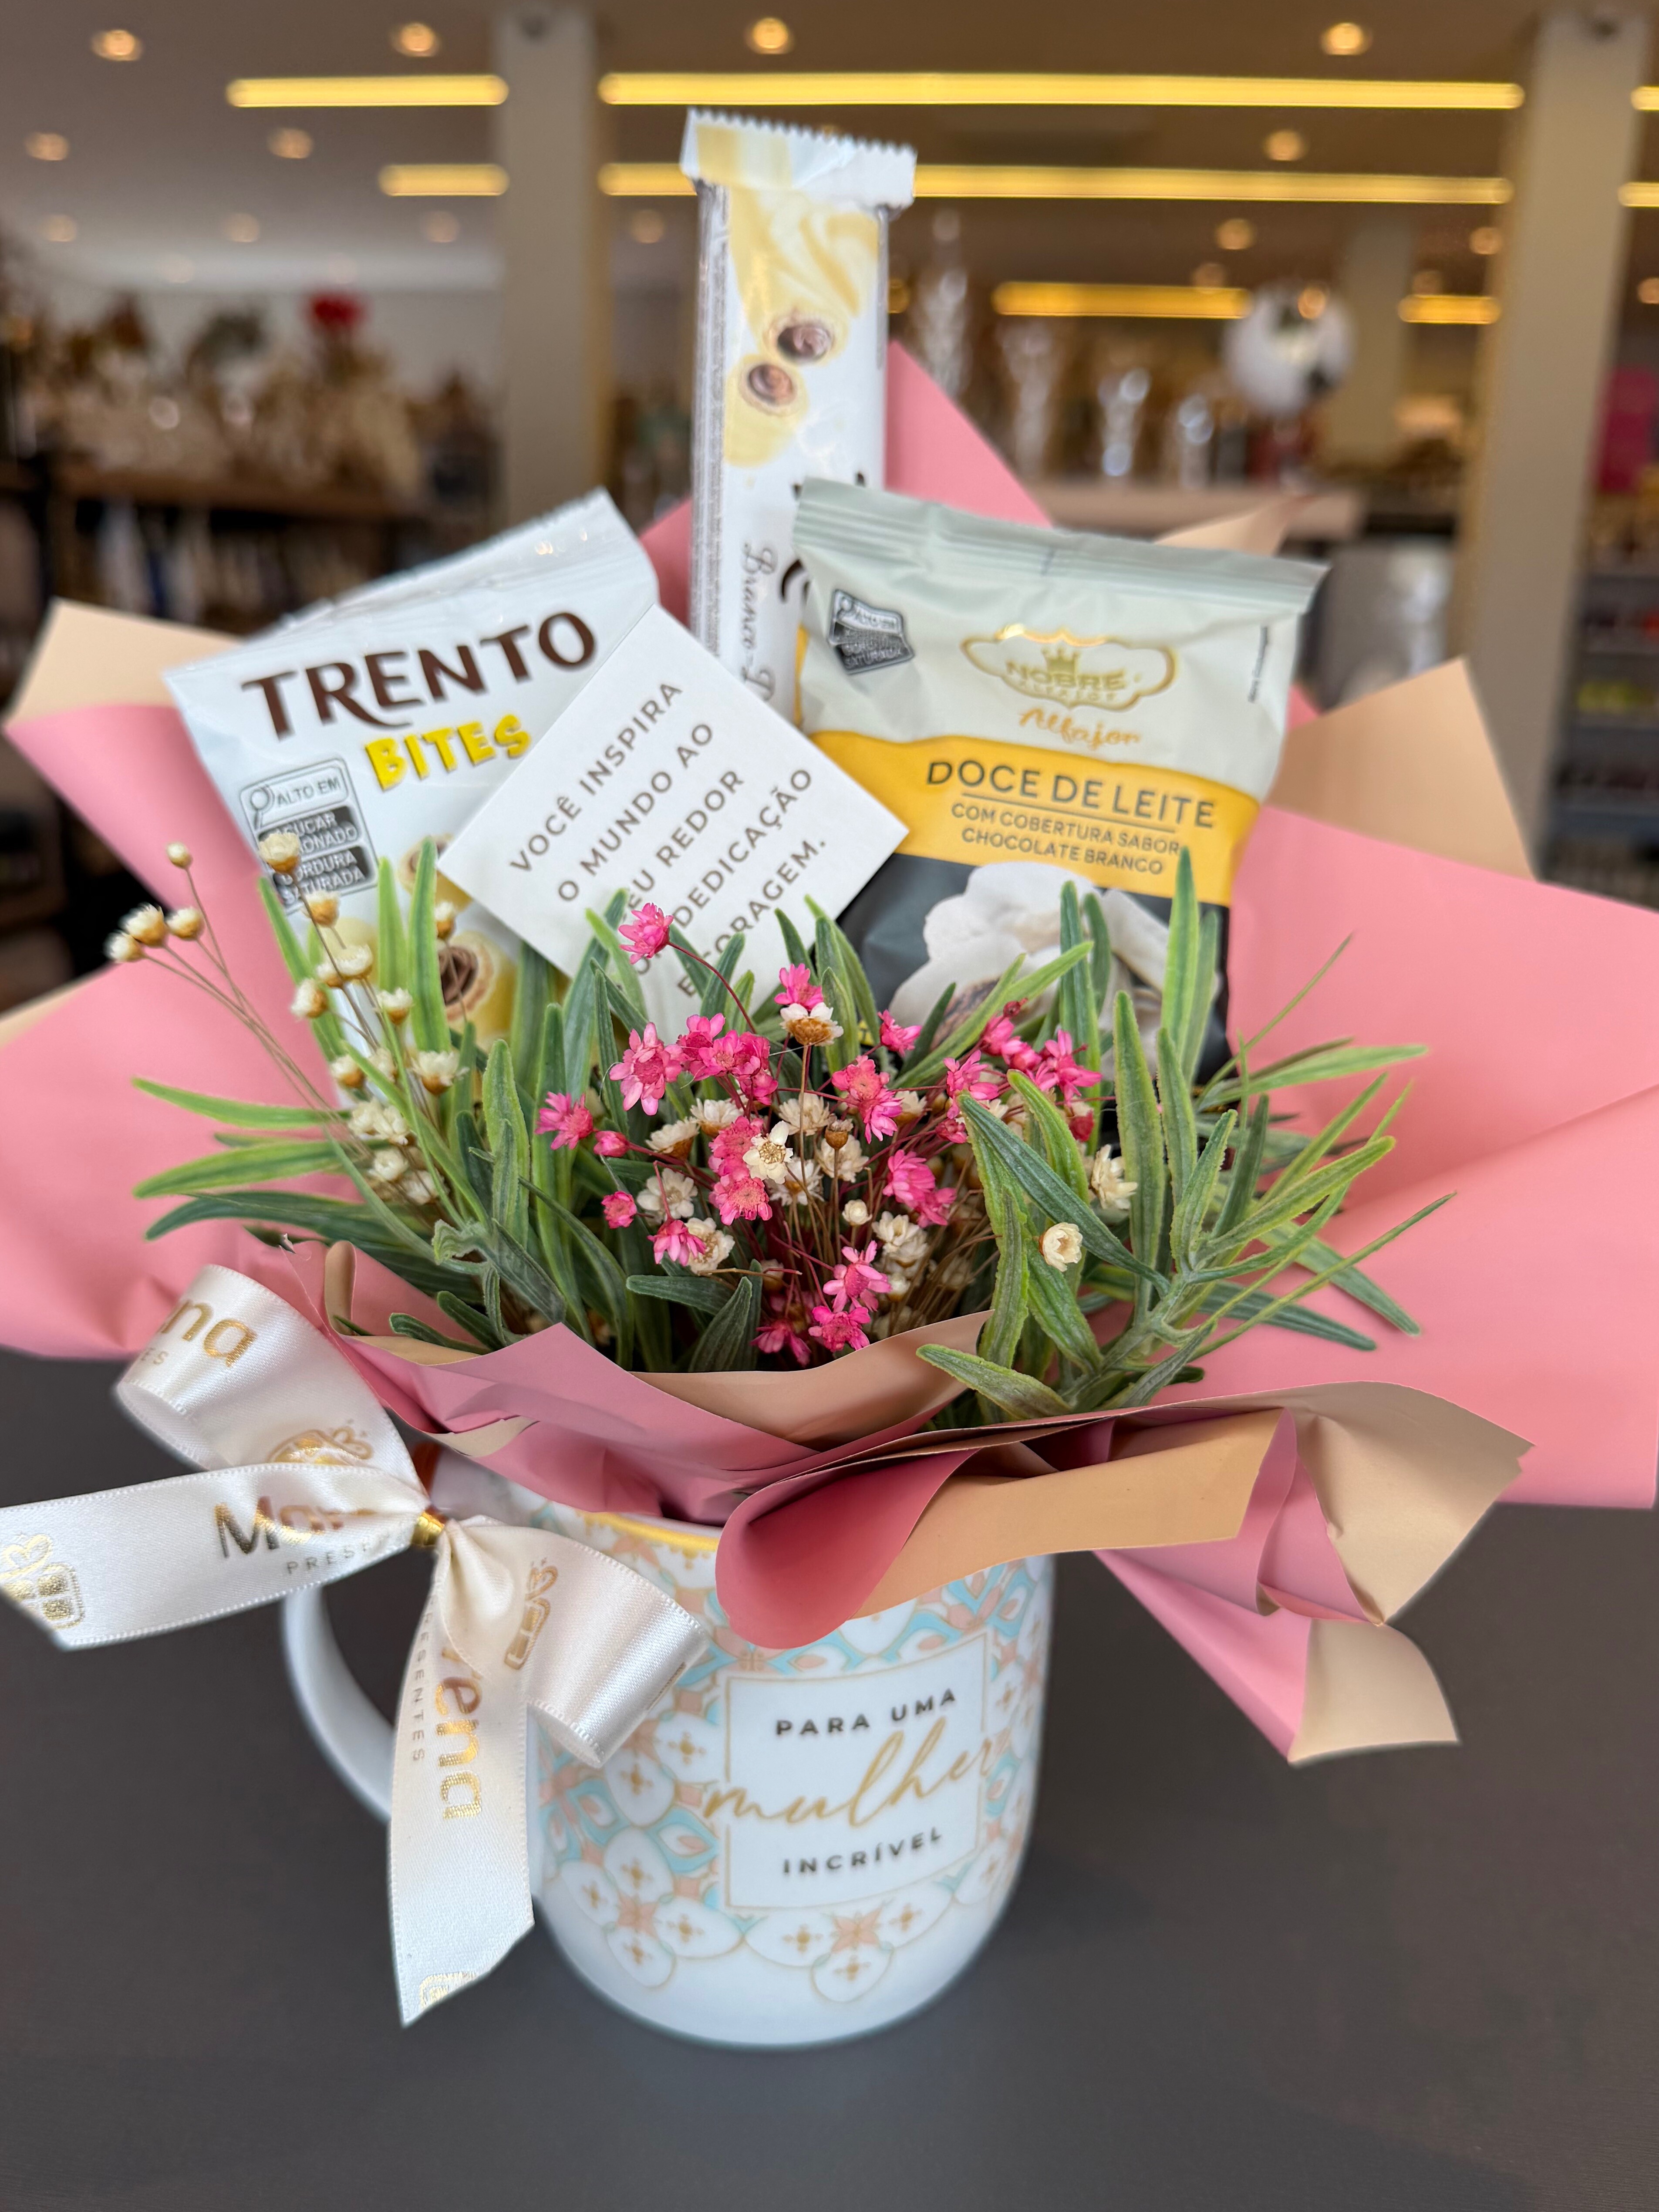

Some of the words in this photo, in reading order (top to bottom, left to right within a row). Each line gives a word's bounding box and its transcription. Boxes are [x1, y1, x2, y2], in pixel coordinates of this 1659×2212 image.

[239, 611, 598, 742] TRENTO
[1006, 660, 1127, 691] NOBRE
[364, 714, 532, 791] BITES
[510, 796, 582, 873] VOCÊ
[579, 682, 683, 796] INSPIRA
[278, 786, 314, 806] ALTO
[318, 776, 341, 794] EM
[558, 880, 580, 902] O
[580, 770, 673, 877] MUNDO
[677, 723, 714, 769] AO
[927, 760, 1041, 798] DOCE
[1052, 775, 1103, 809] DE
[1112, 785, 1215, 828] LEITE
[623, 870, 655, 922] EU
[656, 770, 744, 869] REDOR
[673, 769, 812, 928] DEDICAÇÃO
[951, 802, 996, 824] COM
[1000, 811, 1113, 844] COBERTURA
[1117, 832, 1180, 856] SABOR
[961, 827, 1079, 862] CHOCOLATE
[1085, 849, 1163, 875] BRANCO
[702, 840, 826, 957] ORAGEM.
[775, 1714, 871, 1736] PARA
[891, 1688, 956, 1722] UMA
[783, 1828, 942, 1875] INCRÍVEL
